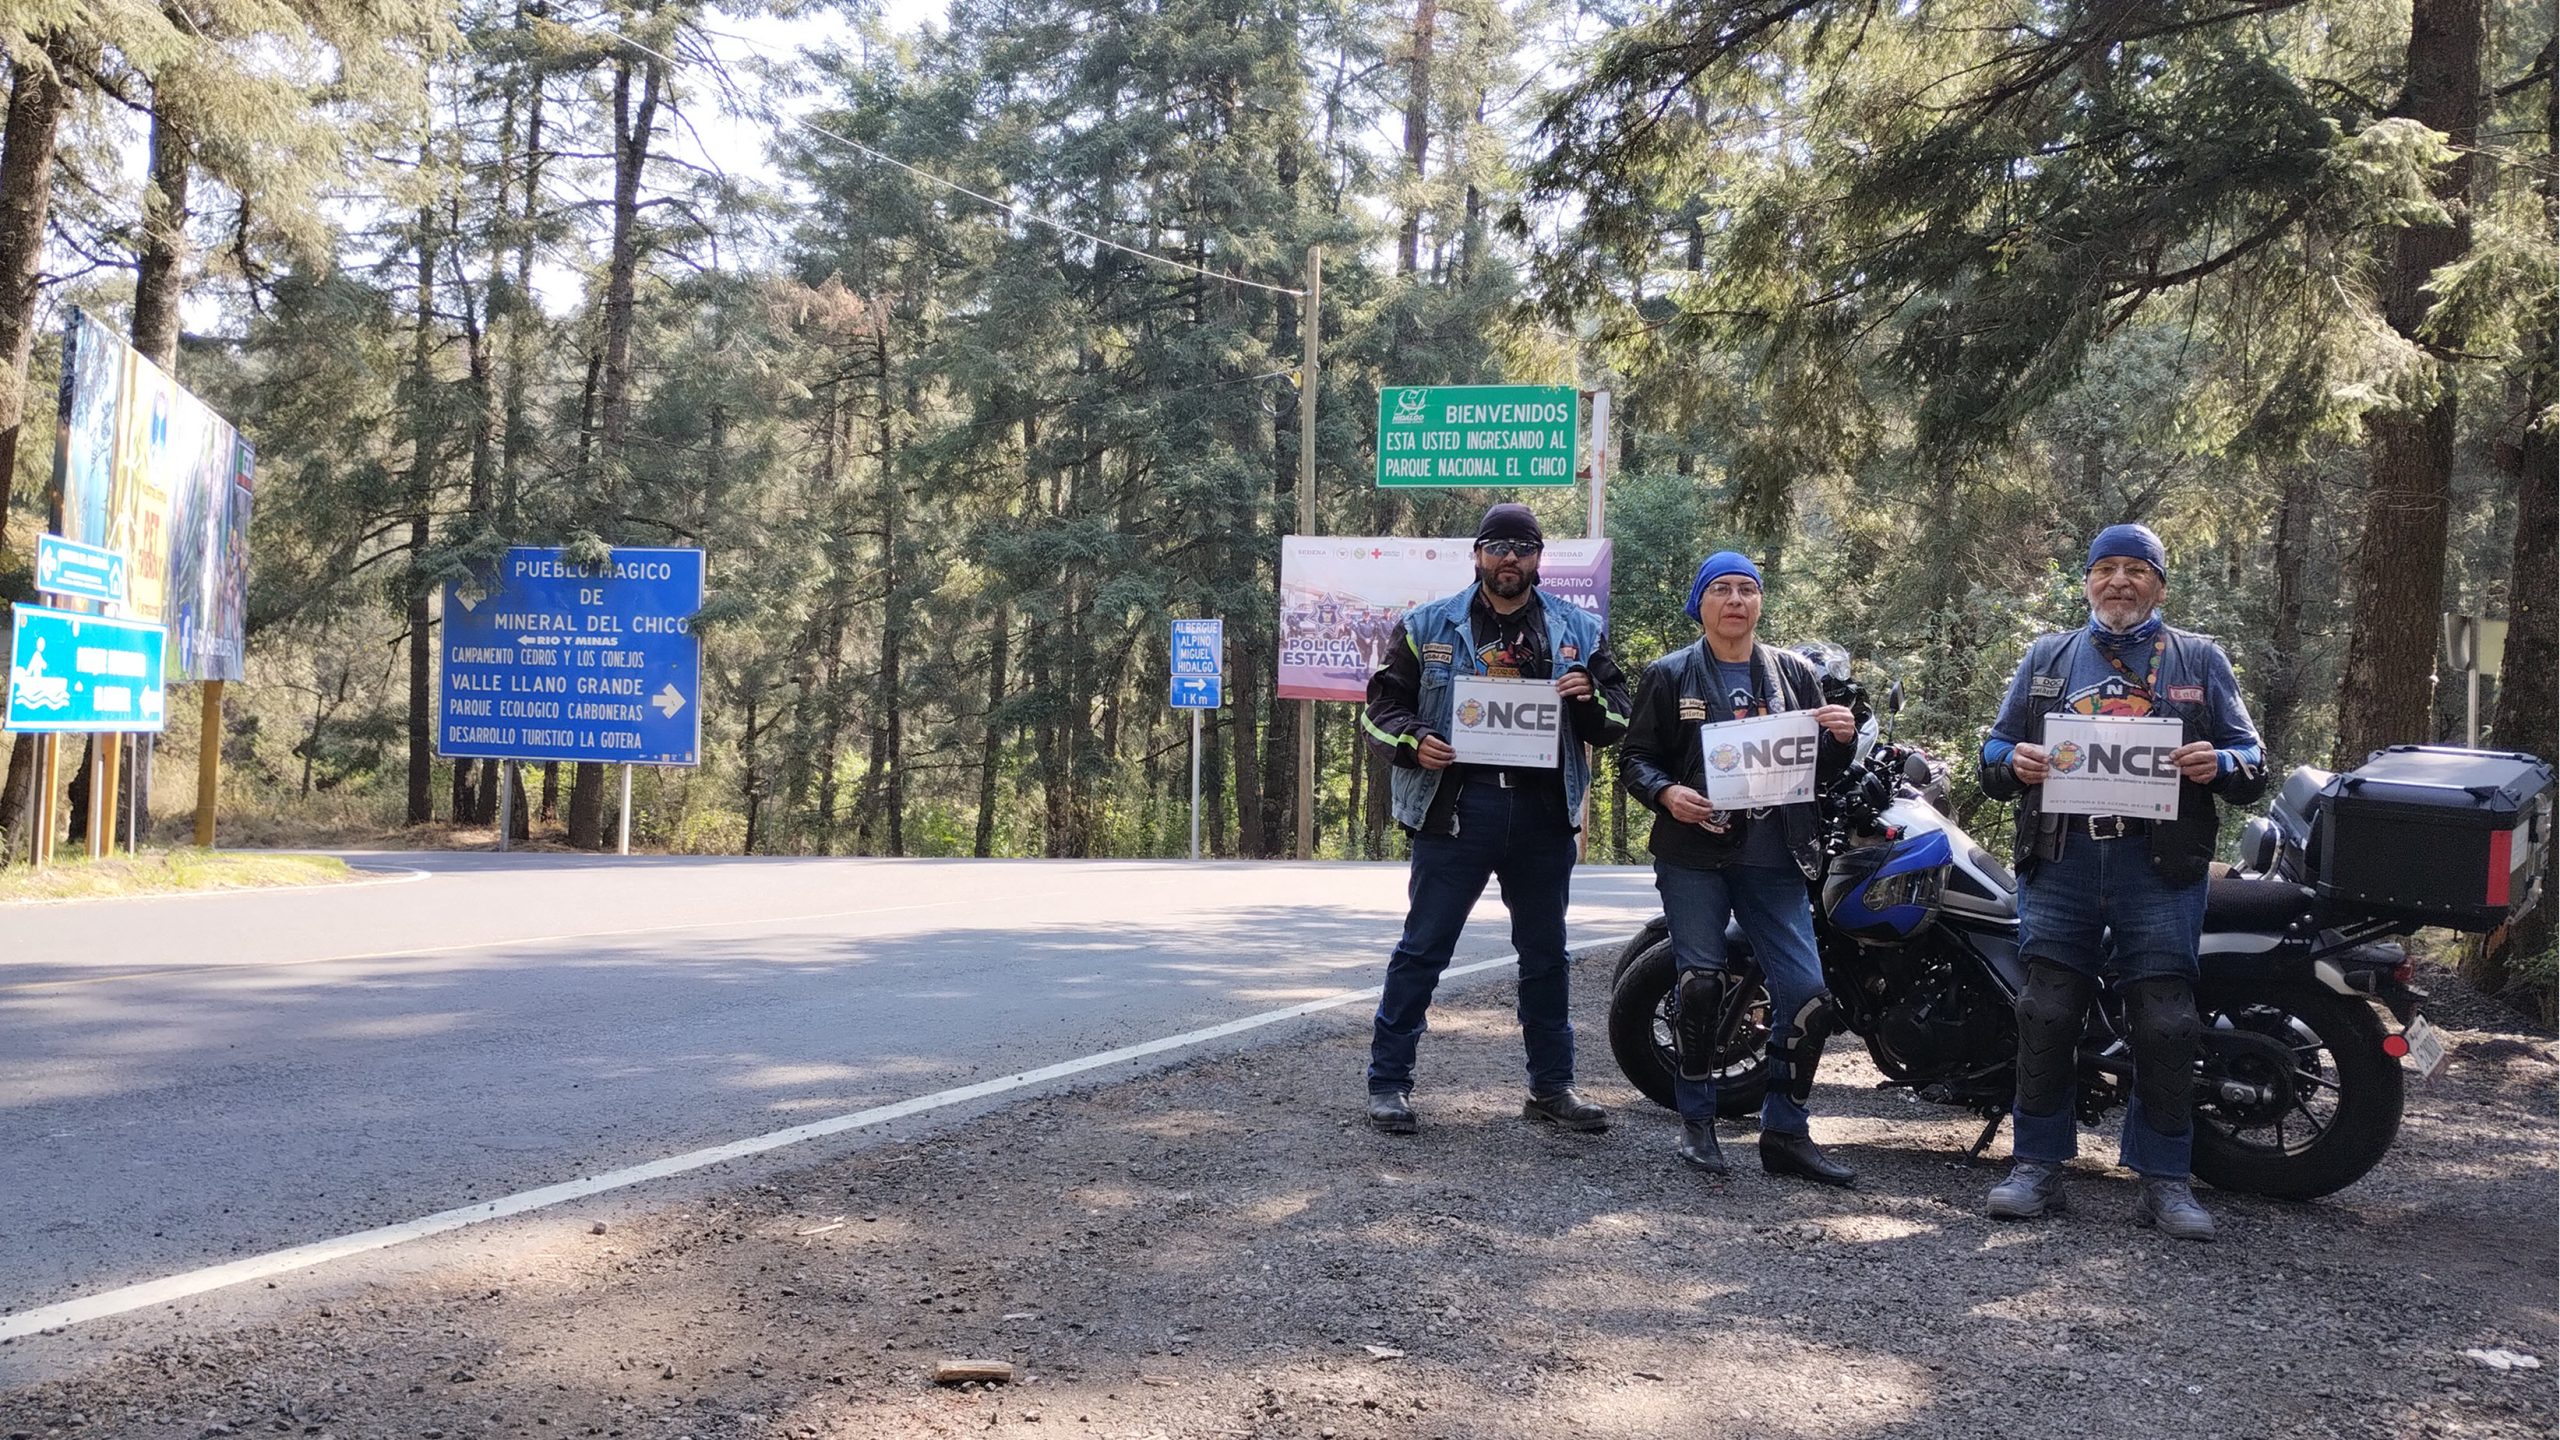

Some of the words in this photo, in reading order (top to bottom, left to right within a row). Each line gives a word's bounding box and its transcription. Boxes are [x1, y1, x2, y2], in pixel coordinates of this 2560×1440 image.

[1446, 403, 1568, 424] BIENVENIDOS
[1386, 432, 1416, 451] ESTA
[1422, 432, 1460, 450] USTED
[1467, 431, 1544, 450] INGRESANDO
[1550, 430, 1567, 449] AL
[1386, 458, 1432, 477] PARQUE
[1438, 458, 1499, 477] NACIONAL
[1506, 457, 1521, 476] EL
[1530, 457, 1567, 476] CHICO
[515, 561, 589, 578] PUEBLO
[580, 589, 604, 605] DE
[495, 614, 578, 631] MINERAL
[587, 616, 623, 633] DEL
[632, 616, 689, 634] CHICO
[1174, 622, 1218, 634] ALBERGUE
[537, 636, 560, 646] RIO
[563, 636, 573, 646] Y
[575, 637, 618, 646] MINAS
[1180, 636, 1211, 646] ALPINO
[1289, 637, 1358, 652] POLICÍA
[452, 647, 514, 665] CAMPAMENTO
[520, 649, 557, 667] CEDROS
[563, 650, 571, 666] Y
[577, 651, 595, 667] LOS
[601, 651, 645, 668] CONEJOS
[1180, 648, 1210, 660] MIGUEL
[1283, 652, 1365, 668] ESTATAL
[1177, 661, 1213, 672] HIDALGO
[452, 674, 502, 691] VALLE
[511, 675, 567, 693] LLANO
[577, 677, 644, 695] GRANDE
[2107, 685, 2123, 694] N
[450, 699, 492, 717] PARQUE
[500, 700, 559, 719] ECOLOGICO
[568, 702, 643, 721] CARBONERAS
[449, 726, 516, 745] DESARROLLO
[521, 728, 574, 747] TURISTICO
[580, 731, 595, 748] LA
[601, 731, 642, 749] GOTERA
